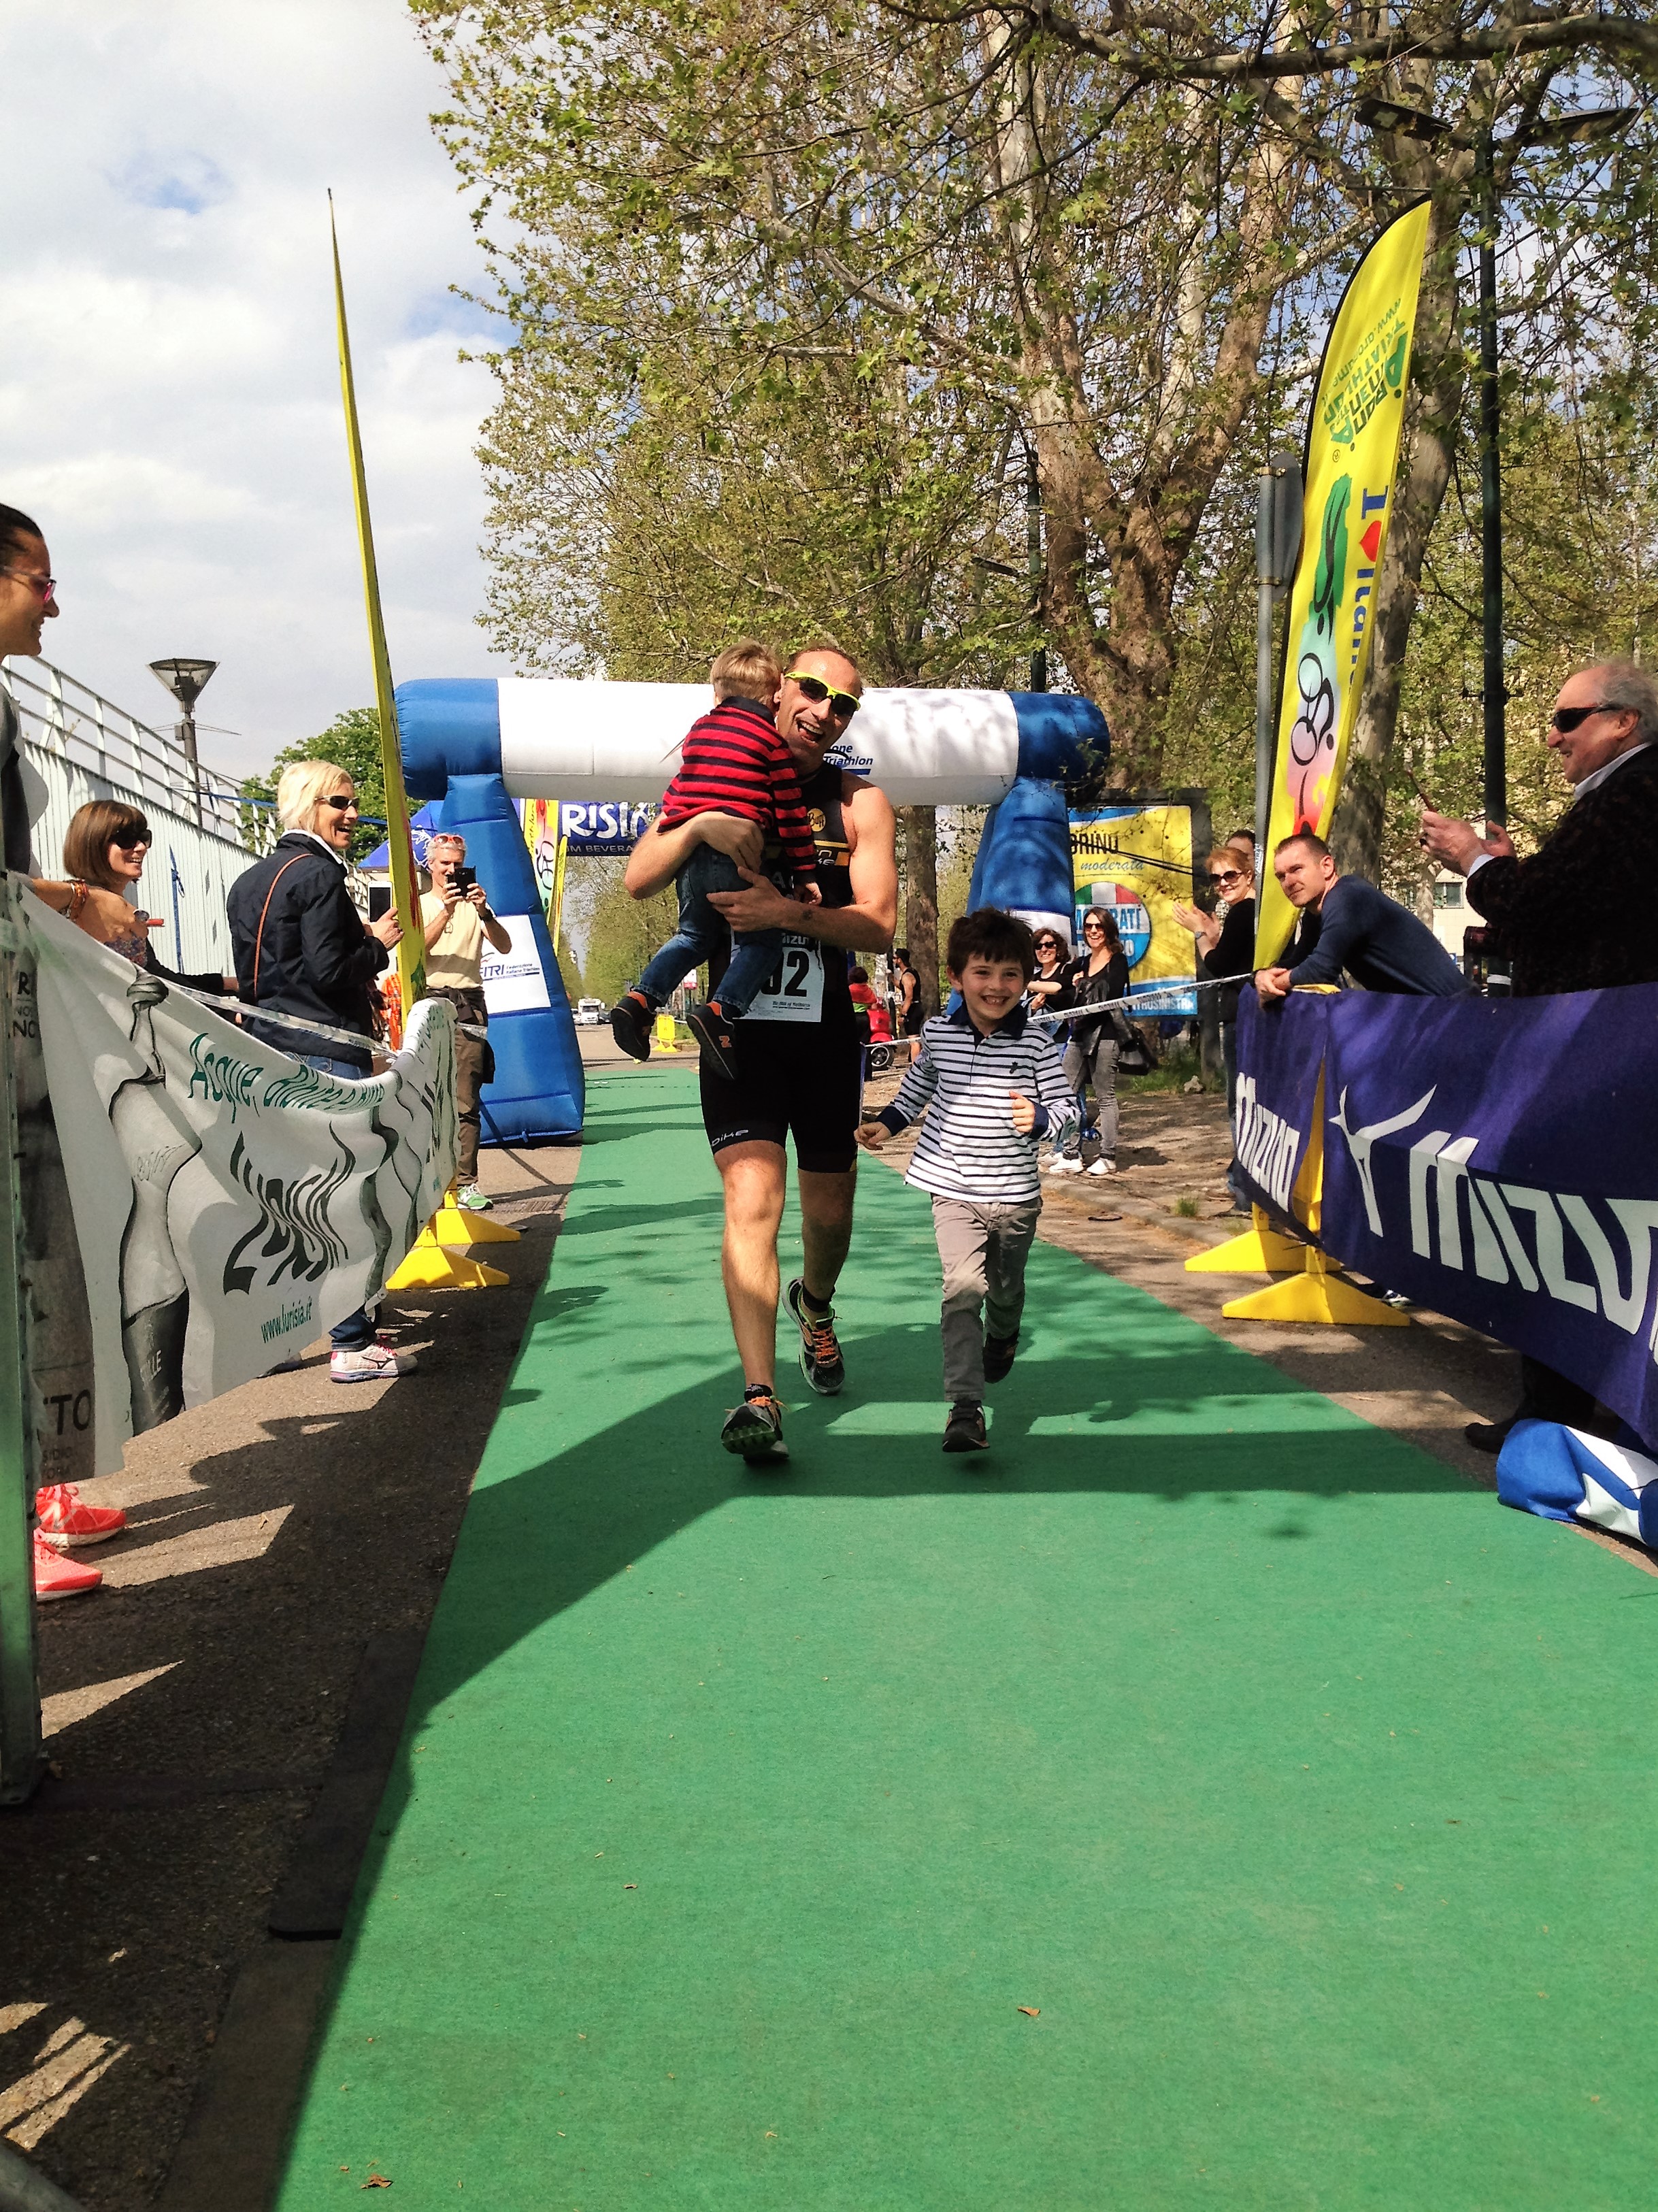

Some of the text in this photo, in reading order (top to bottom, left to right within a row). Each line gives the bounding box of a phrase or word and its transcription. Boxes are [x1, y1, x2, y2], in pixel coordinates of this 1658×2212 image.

[823, 755, 874, 765] Triathlon
[1080, 857, 1144, 871] moderata
[1409, 1129, 1658, 1366] MIZU
